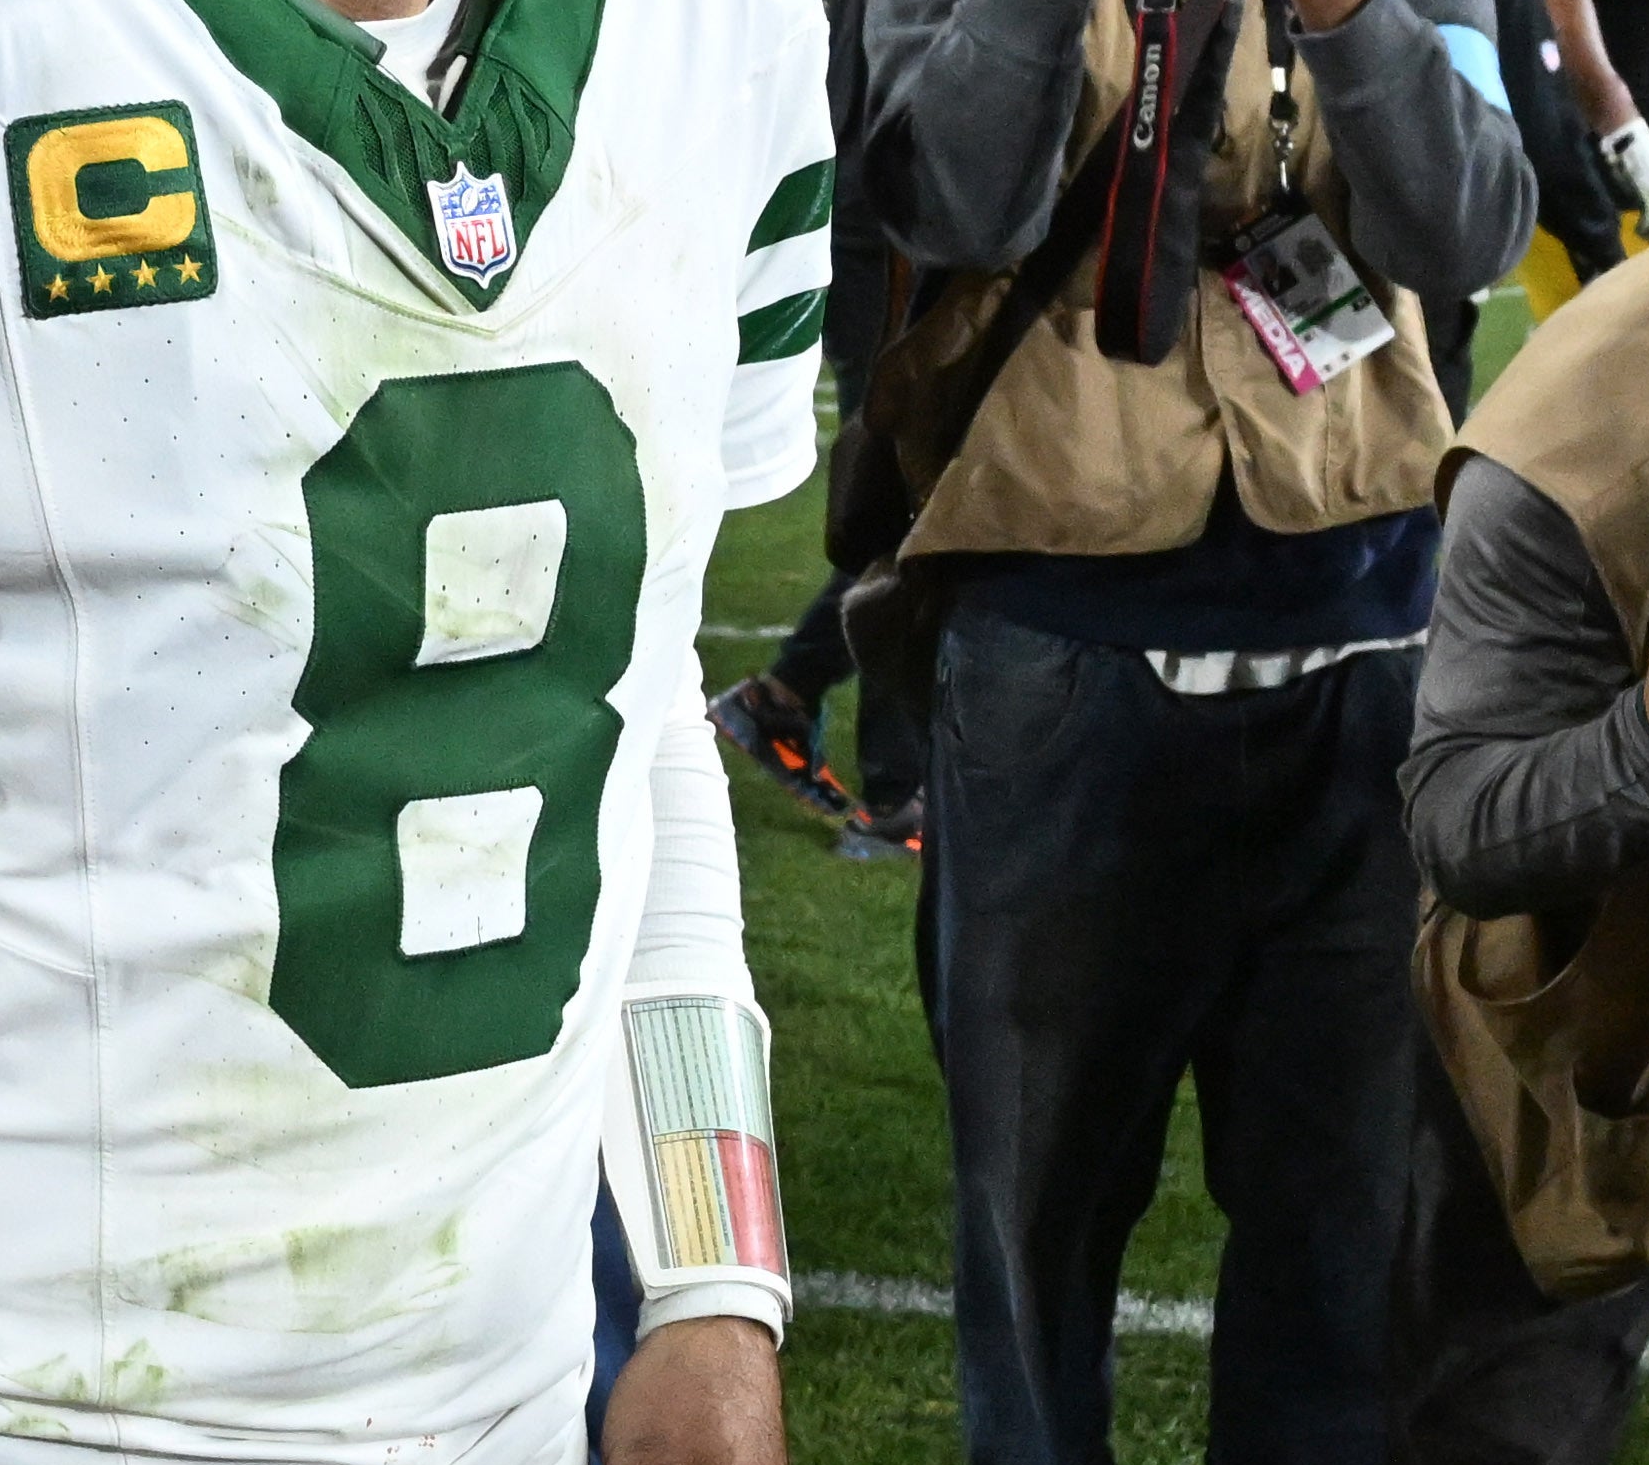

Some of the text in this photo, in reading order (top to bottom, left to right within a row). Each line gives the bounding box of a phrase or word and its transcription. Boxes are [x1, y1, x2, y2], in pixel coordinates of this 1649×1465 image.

[1133, 43, 1162, 150] Canon
[27, 115, 197, 263] C
[449, 218, 505, 264] NFL
[1234, 278, 1305, 379] MEDIA
[270, 360, 647, 1090] 8
